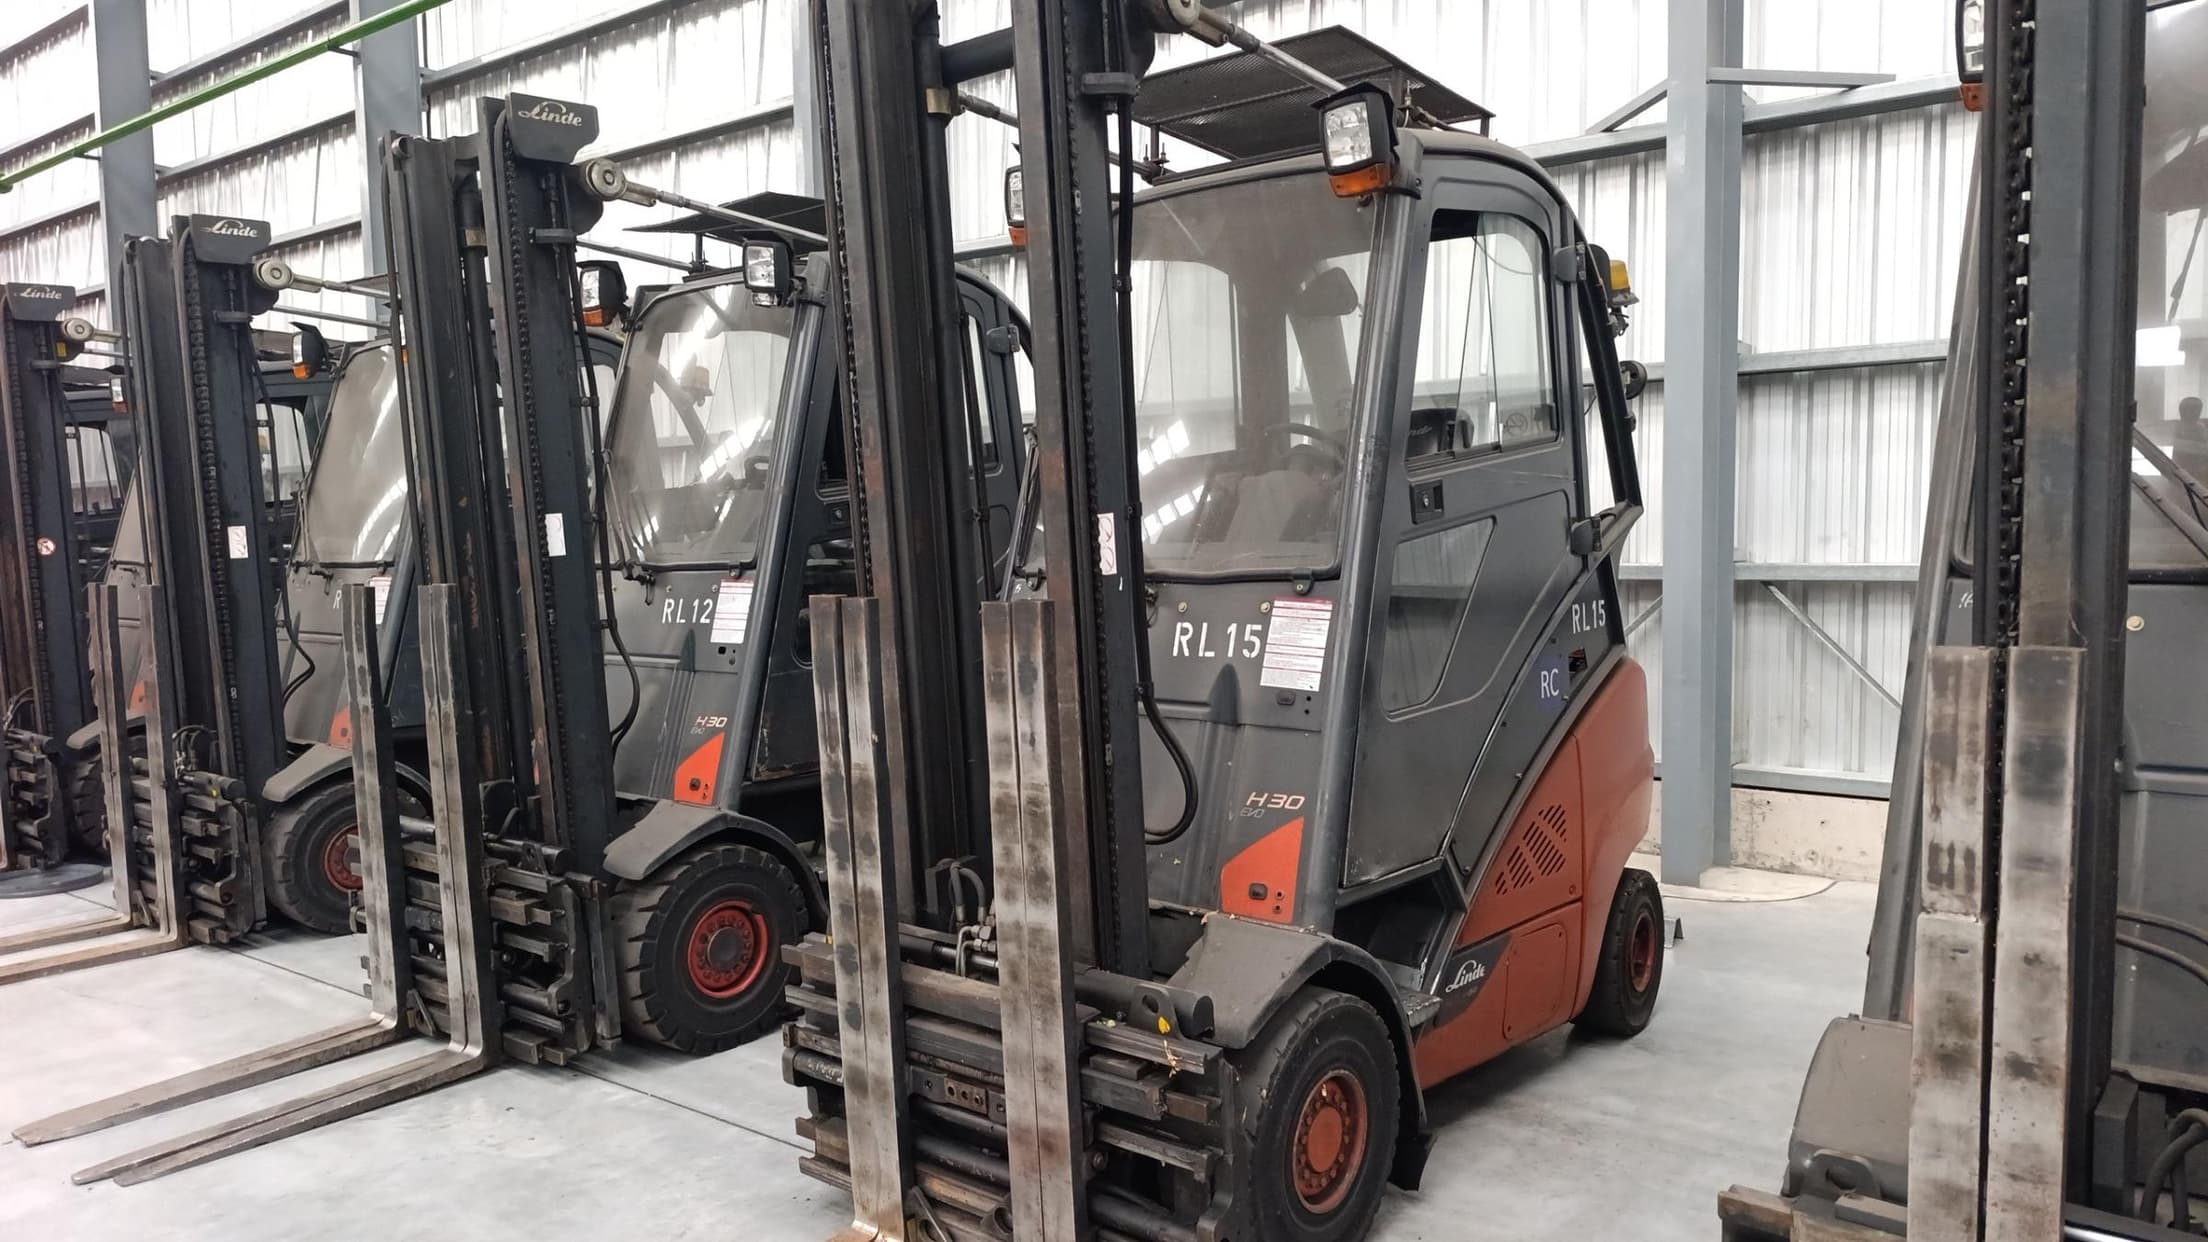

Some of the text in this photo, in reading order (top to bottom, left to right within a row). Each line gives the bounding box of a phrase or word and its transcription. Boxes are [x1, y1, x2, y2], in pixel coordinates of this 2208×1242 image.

[517, 101, 583, 127] Linde
[200, 219, 259, 238] Linde
[14, 285, 63, 300] Linde
[1540, 668, 1560, 699] RC
[1239, 807, 1265, 818] EVO
[1445, 959, 1486, 993] Linde
